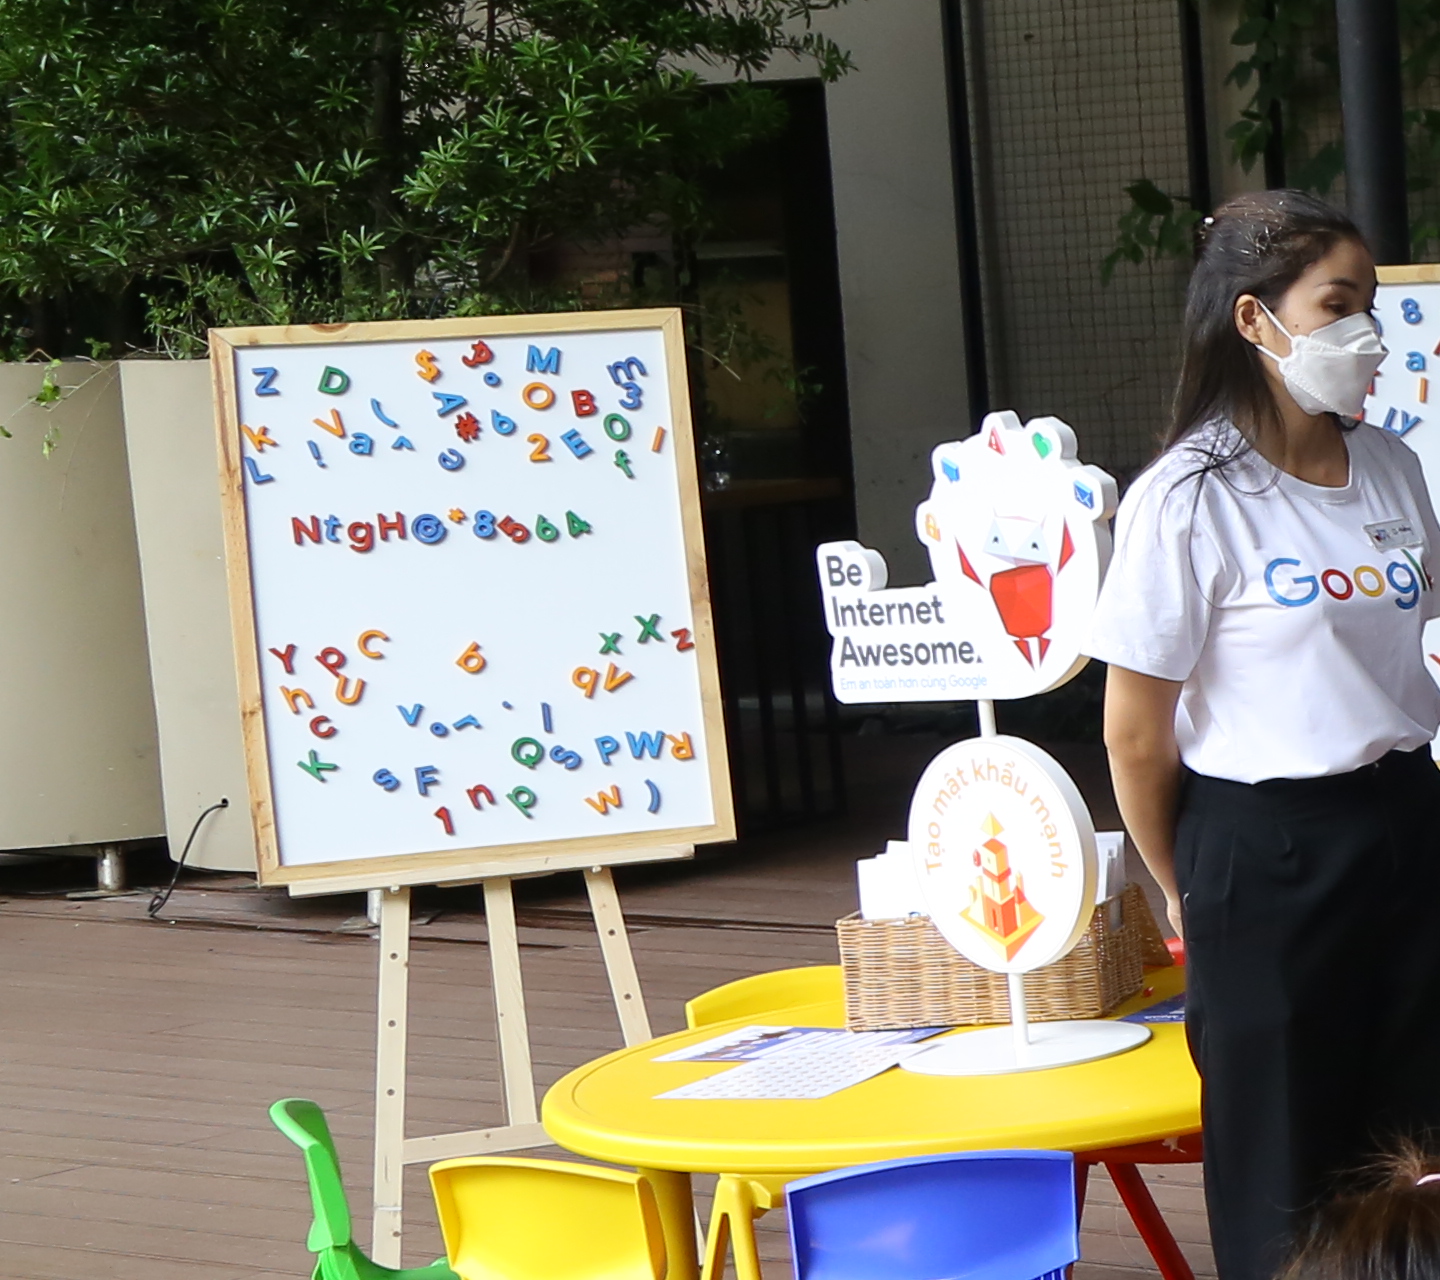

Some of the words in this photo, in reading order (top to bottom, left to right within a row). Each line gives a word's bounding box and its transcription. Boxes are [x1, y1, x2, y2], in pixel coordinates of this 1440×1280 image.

[1401, 297, 1423, 324] 8
[319, 366, 350, 395] D
[571, 389, 597, 417] B
[349, 431, 374, 455] a
[527, 433, 550, 462] 2
[560, 428, 593, 458] E
[826, 555, 862, 587] Be
[1263, 548, 1434, 610] Googl
[832, 595, 945, 627] Internet
[270, 644, 295, 673] Y
[512, 737, 545, 767] Q
[415, 765, 438, 794] F
[925, 821, 946, 875] Tạo
[1030, 795, 1069, 878] mạnh
